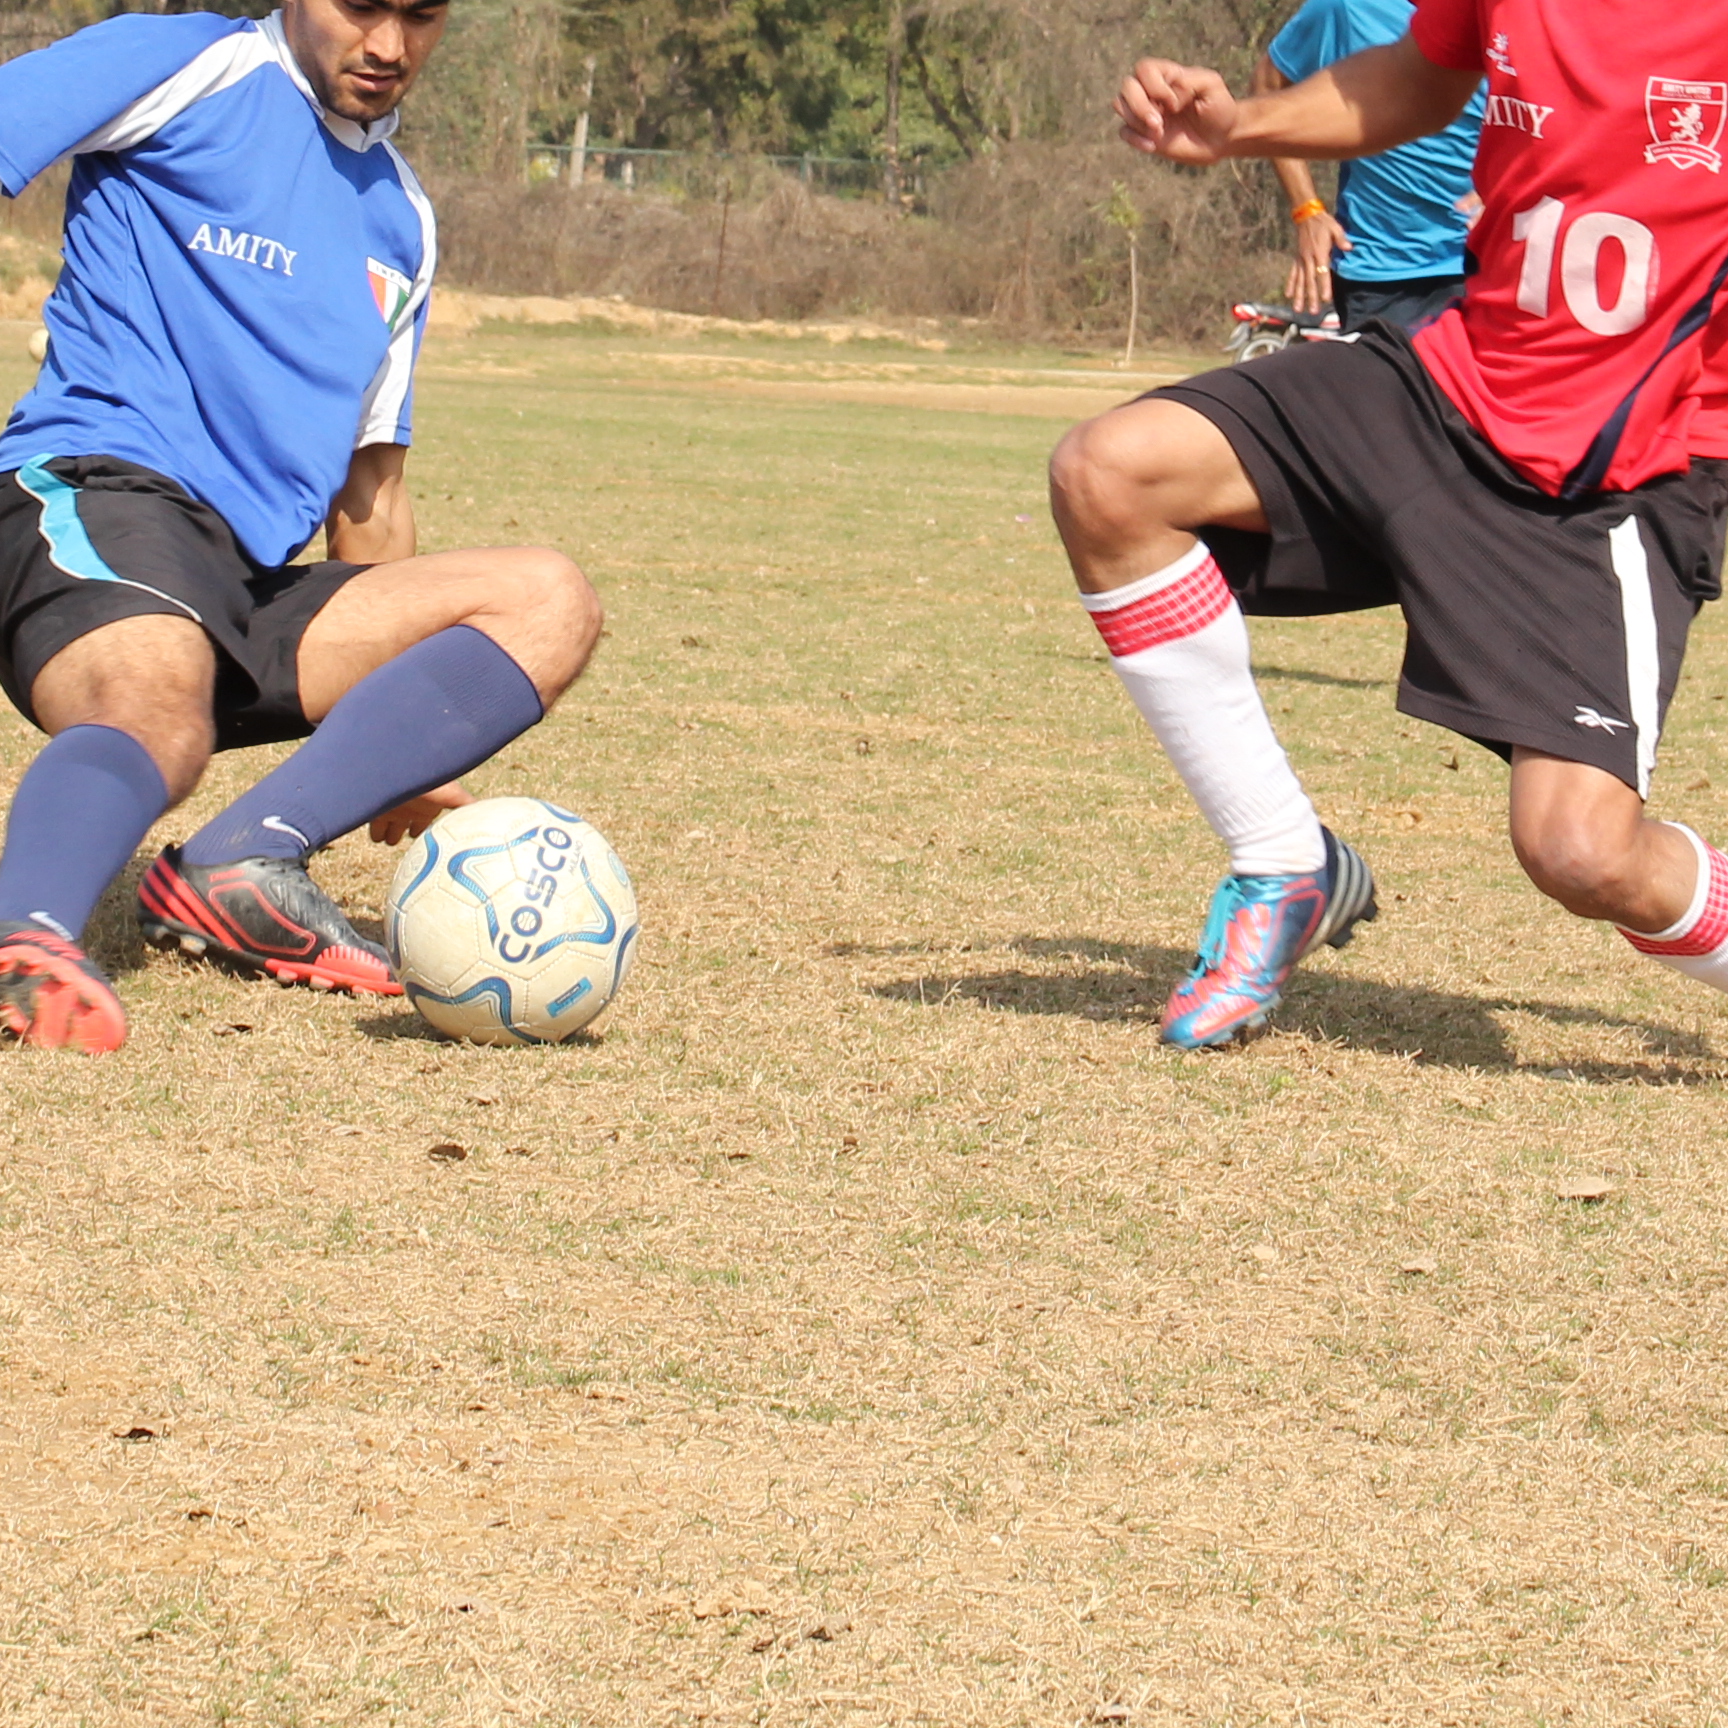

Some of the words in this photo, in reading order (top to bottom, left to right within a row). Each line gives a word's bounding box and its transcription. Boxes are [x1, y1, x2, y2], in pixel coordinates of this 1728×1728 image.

[1482, 95, 1554, 140] MITY
[187, 223, 298, 277] AMITY
[1511, 194, 1661, 337] 10
[498, 826, 573, 964] COSCO
